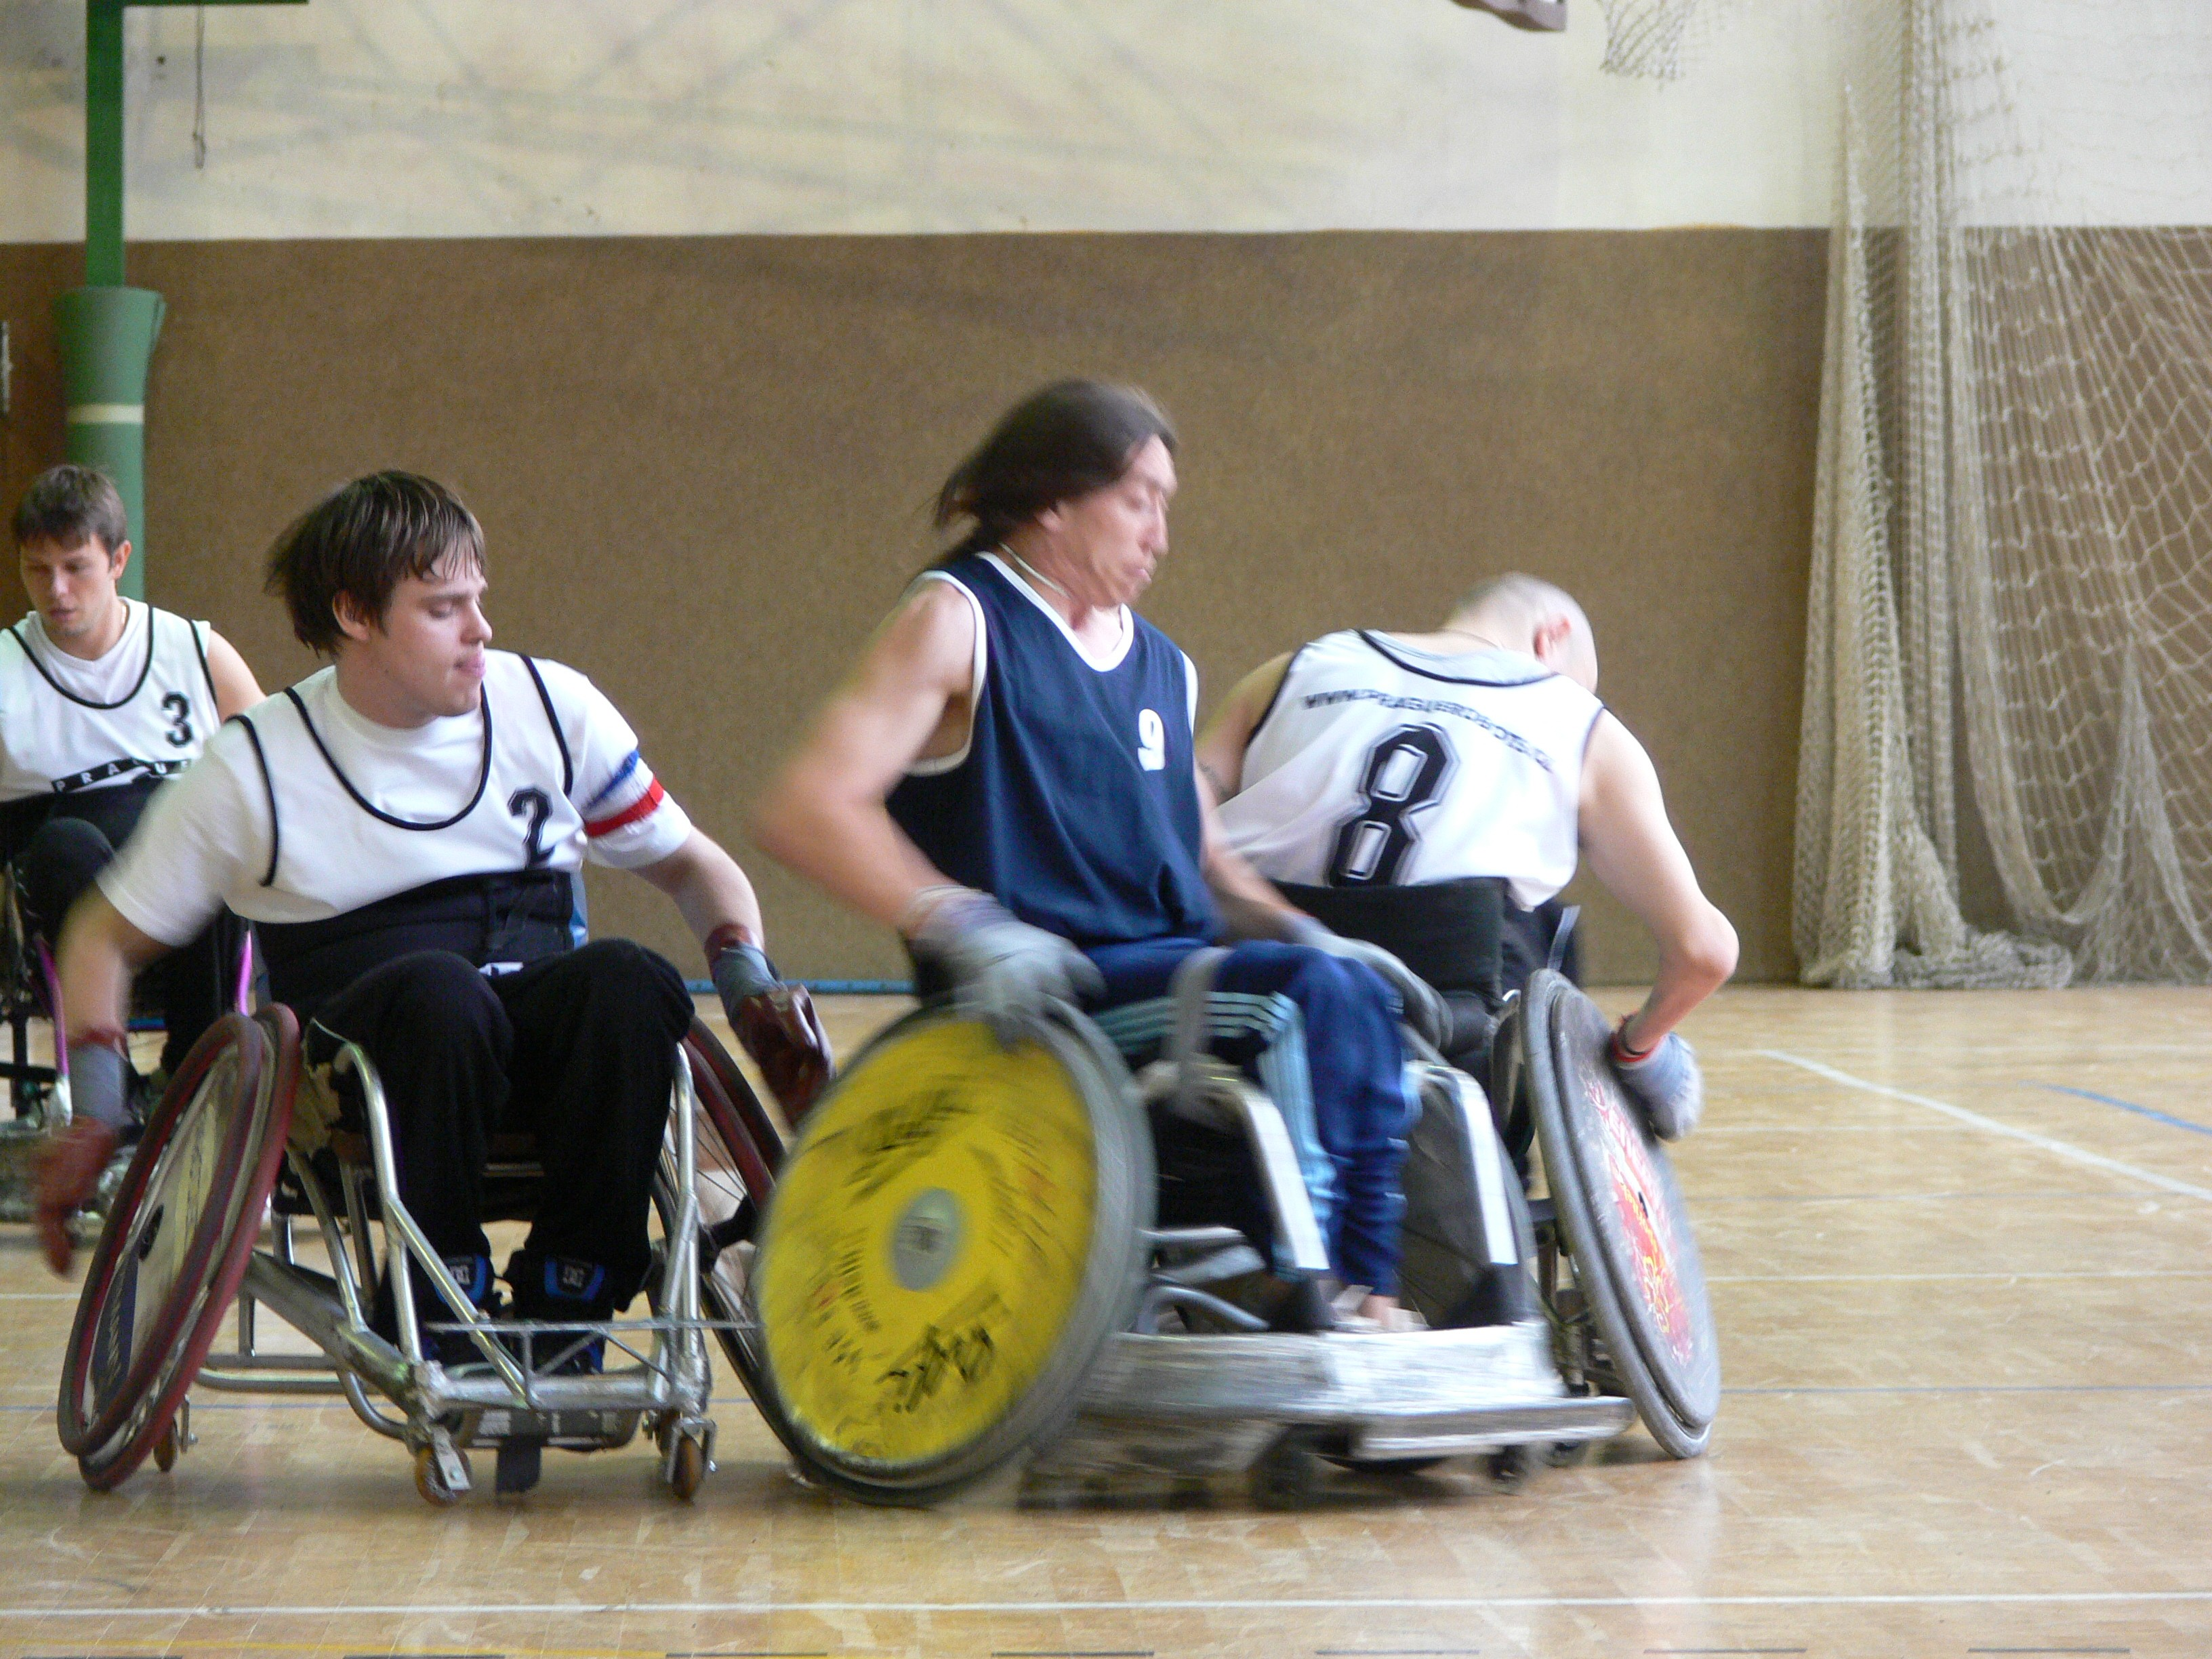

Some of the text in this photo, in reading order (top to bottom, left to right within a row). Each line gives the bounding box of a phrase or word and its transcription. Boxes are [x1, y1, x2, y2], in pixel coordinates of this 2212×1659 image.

[163, 691, 193, 748] 3
[1137, 708, 1166, 771] 9
[54, 759, 188, 793] PRAUE
[1327, 721, 1461, 886] 8
[508, 786, 557, 870] 2
